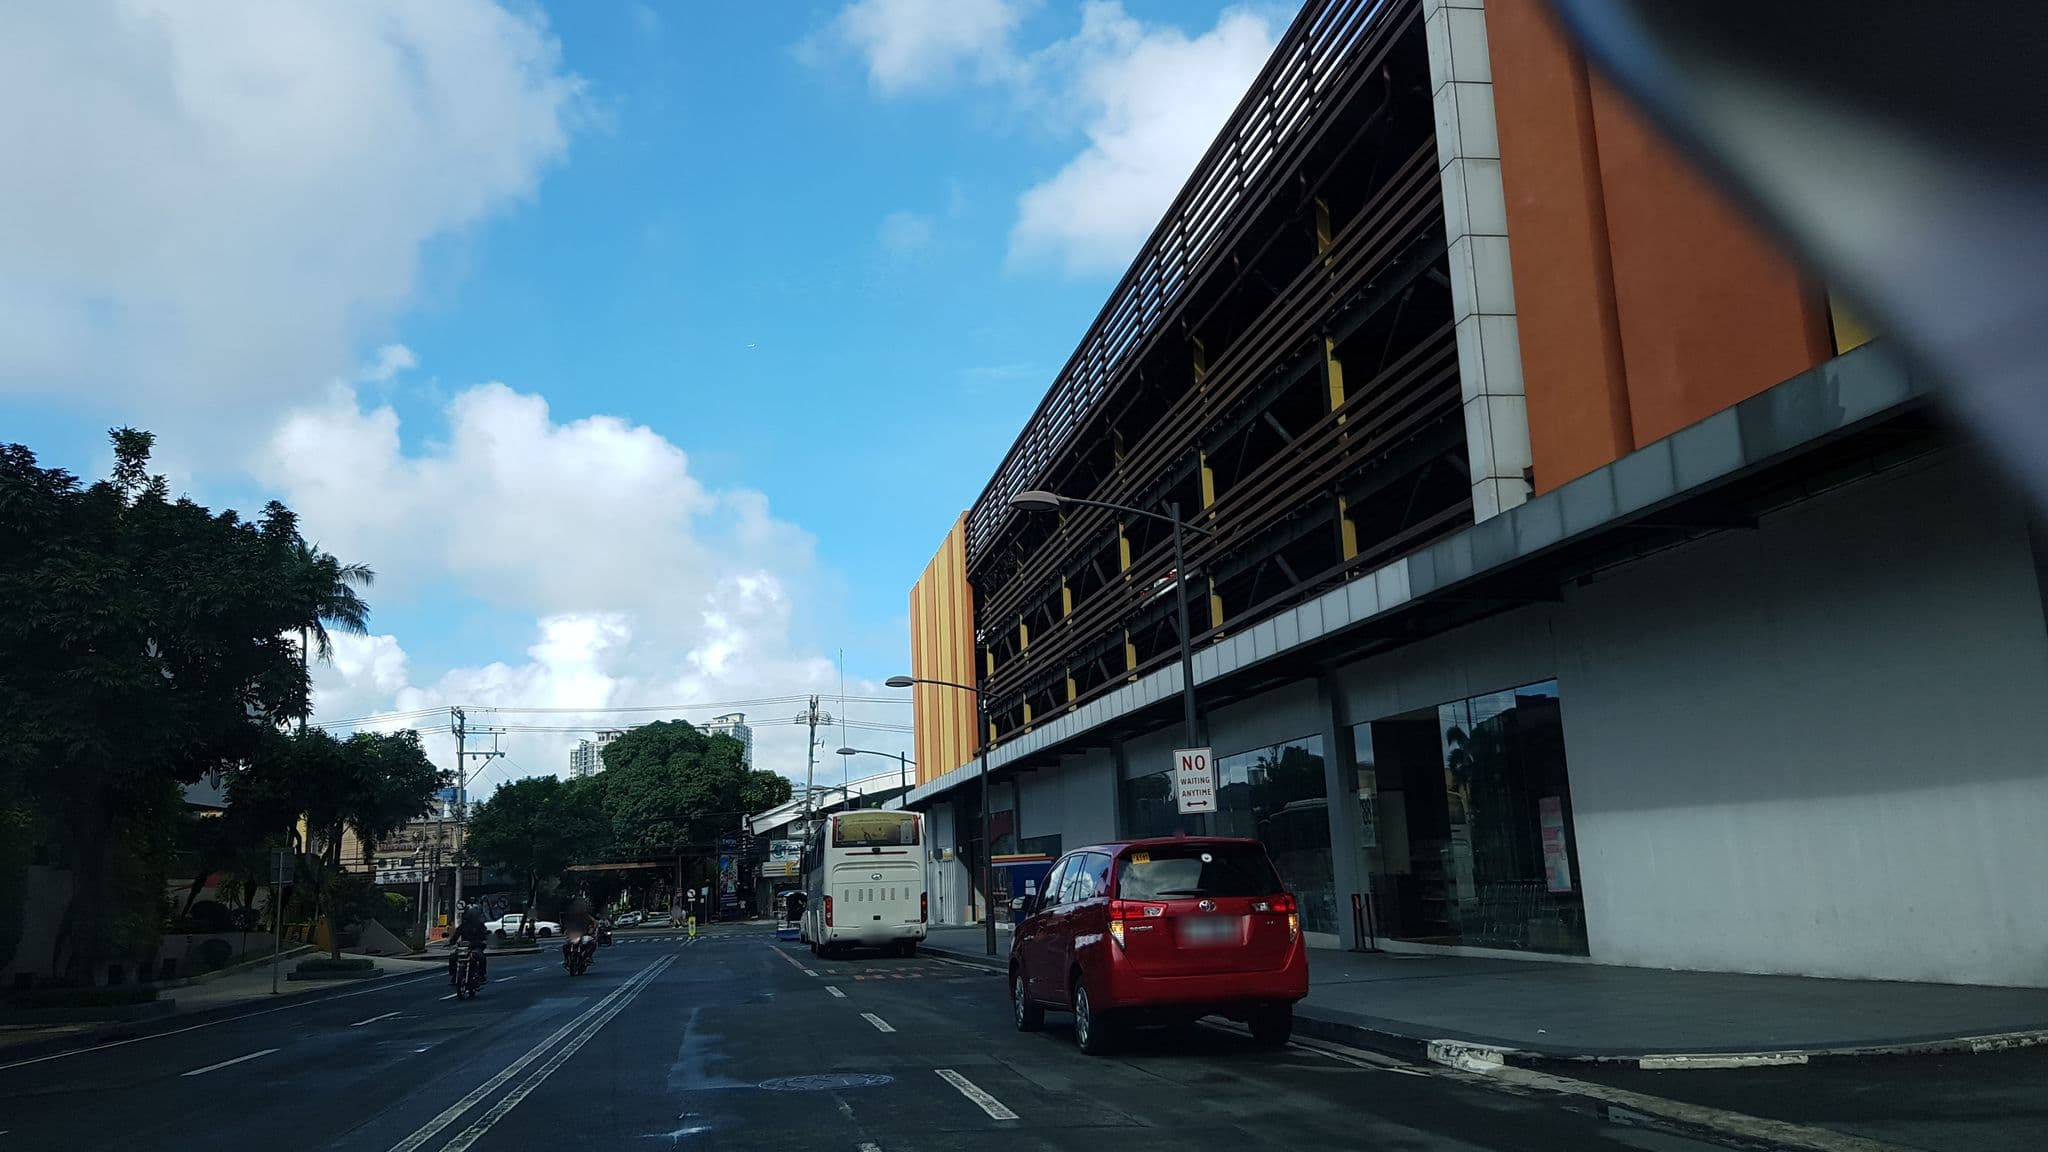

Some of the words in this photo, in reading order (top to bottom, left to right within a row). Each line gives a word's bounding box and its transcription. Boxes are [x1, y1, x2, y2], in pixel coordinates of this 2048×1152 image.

[1182, 755, 1205, 771] NO
[1181, 776, 1210, 785] WAITING
[1182, 788, 1212, 797] ANYTIME
